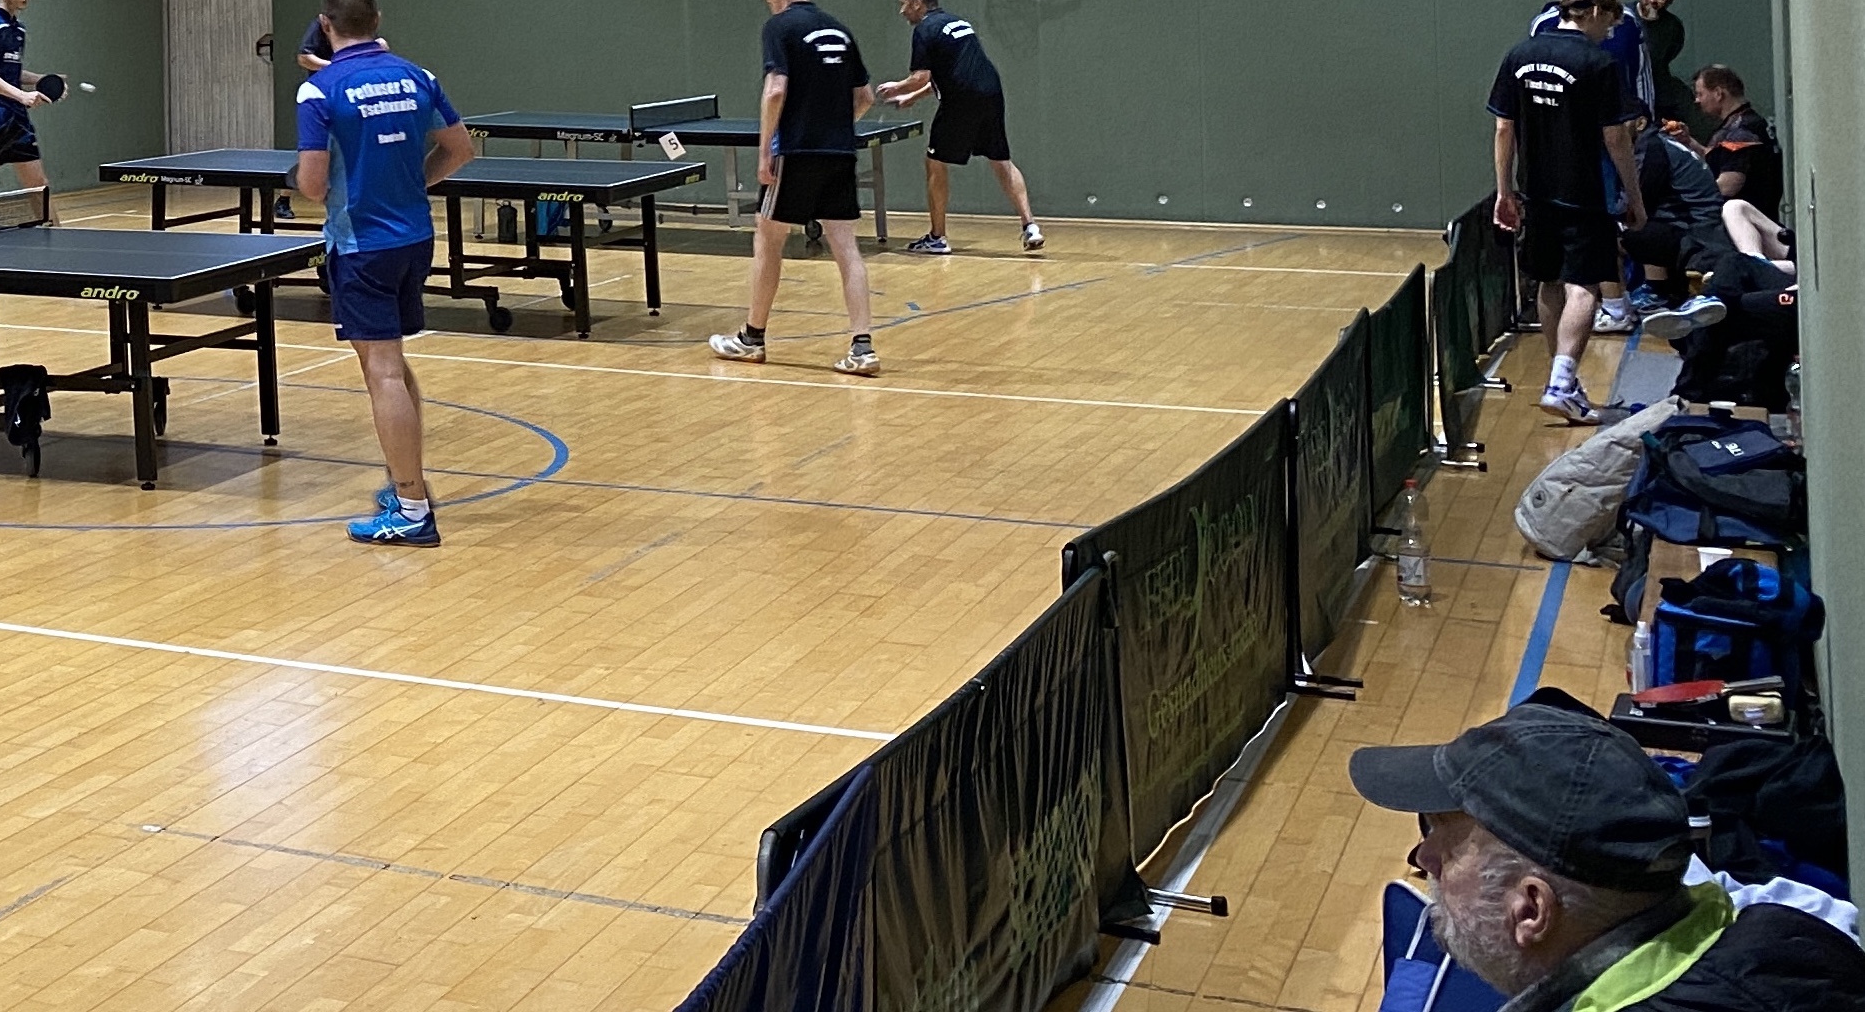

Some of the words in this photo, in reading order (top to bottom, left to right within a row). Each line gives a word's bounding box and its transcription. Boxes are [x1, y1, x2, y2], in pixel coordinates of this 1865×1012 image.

[668, 138, 678, 150] 5
[119, 173, 159, 183] andro
[537, 191, 584, 201] andro
[80, 285, 140, 300] andro
